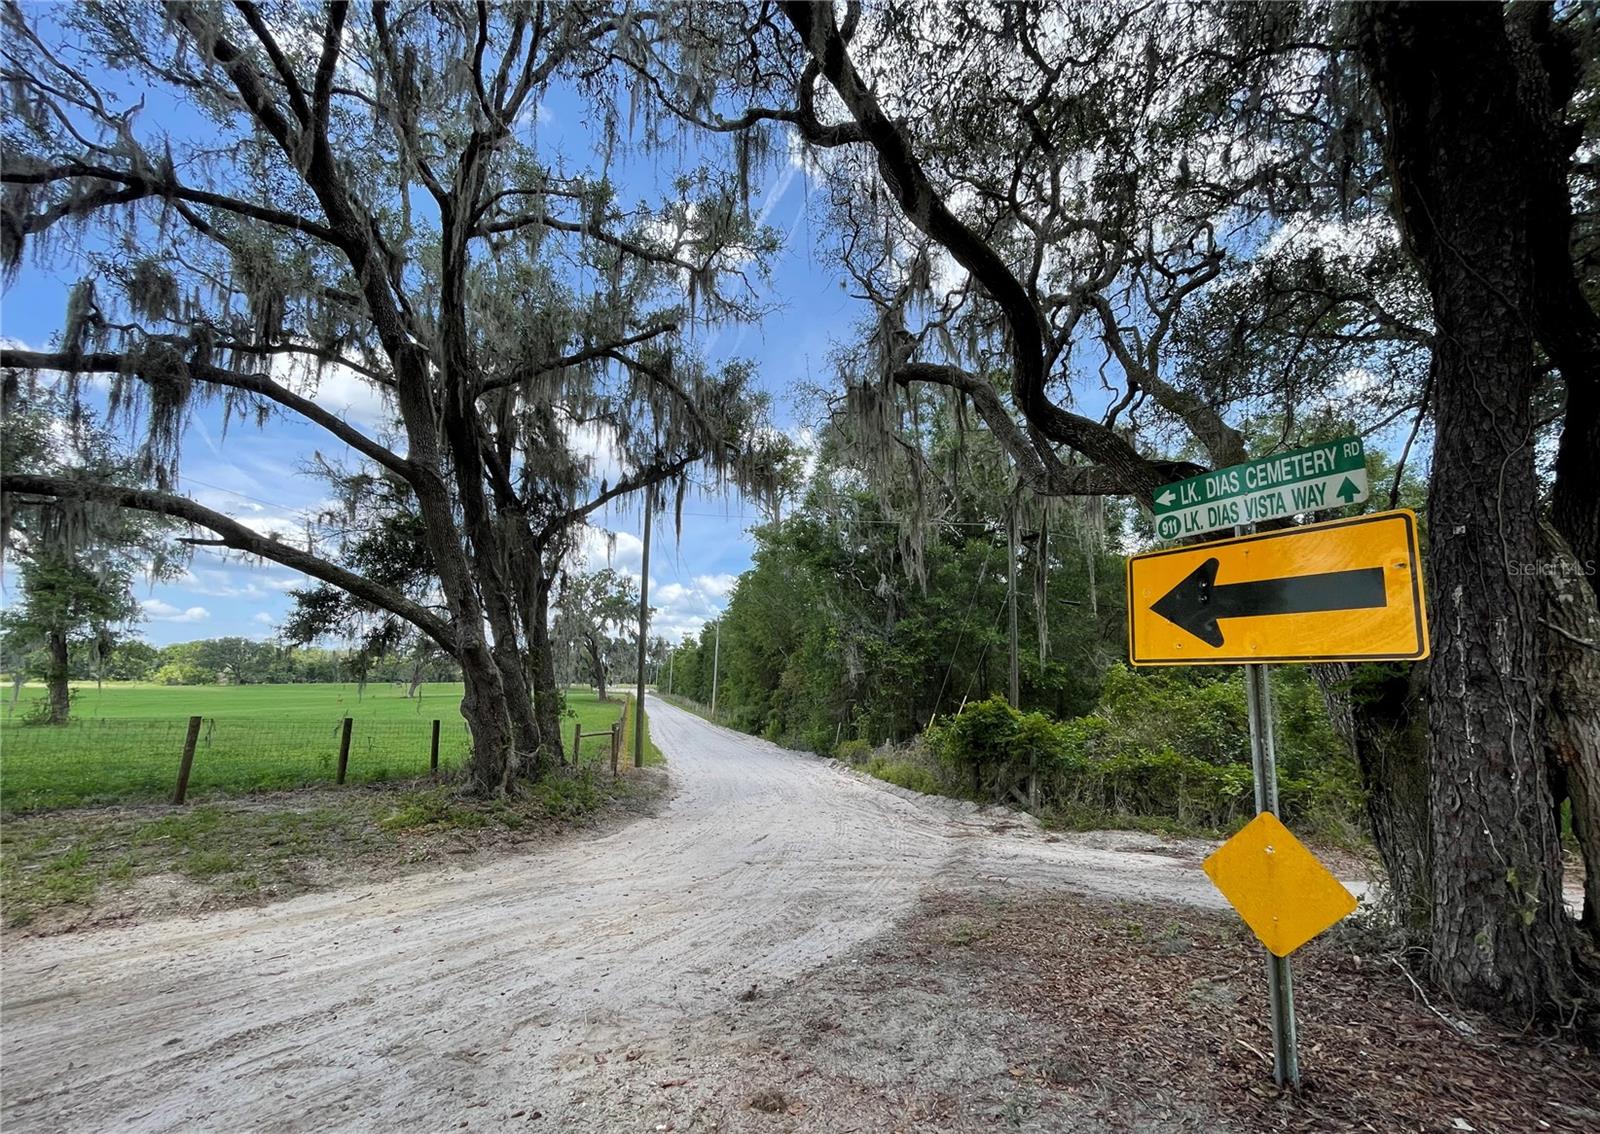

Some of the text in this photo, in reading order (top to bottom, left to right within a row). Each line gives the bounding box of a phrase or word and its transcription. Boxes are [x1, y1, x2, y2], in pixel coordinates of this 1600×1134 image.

[1180, 441, 1360, 505] LK. DIAS CEMETERY RD
[1162, 482, 1327, 536] 911 LK. DIAS VISTA WAY
